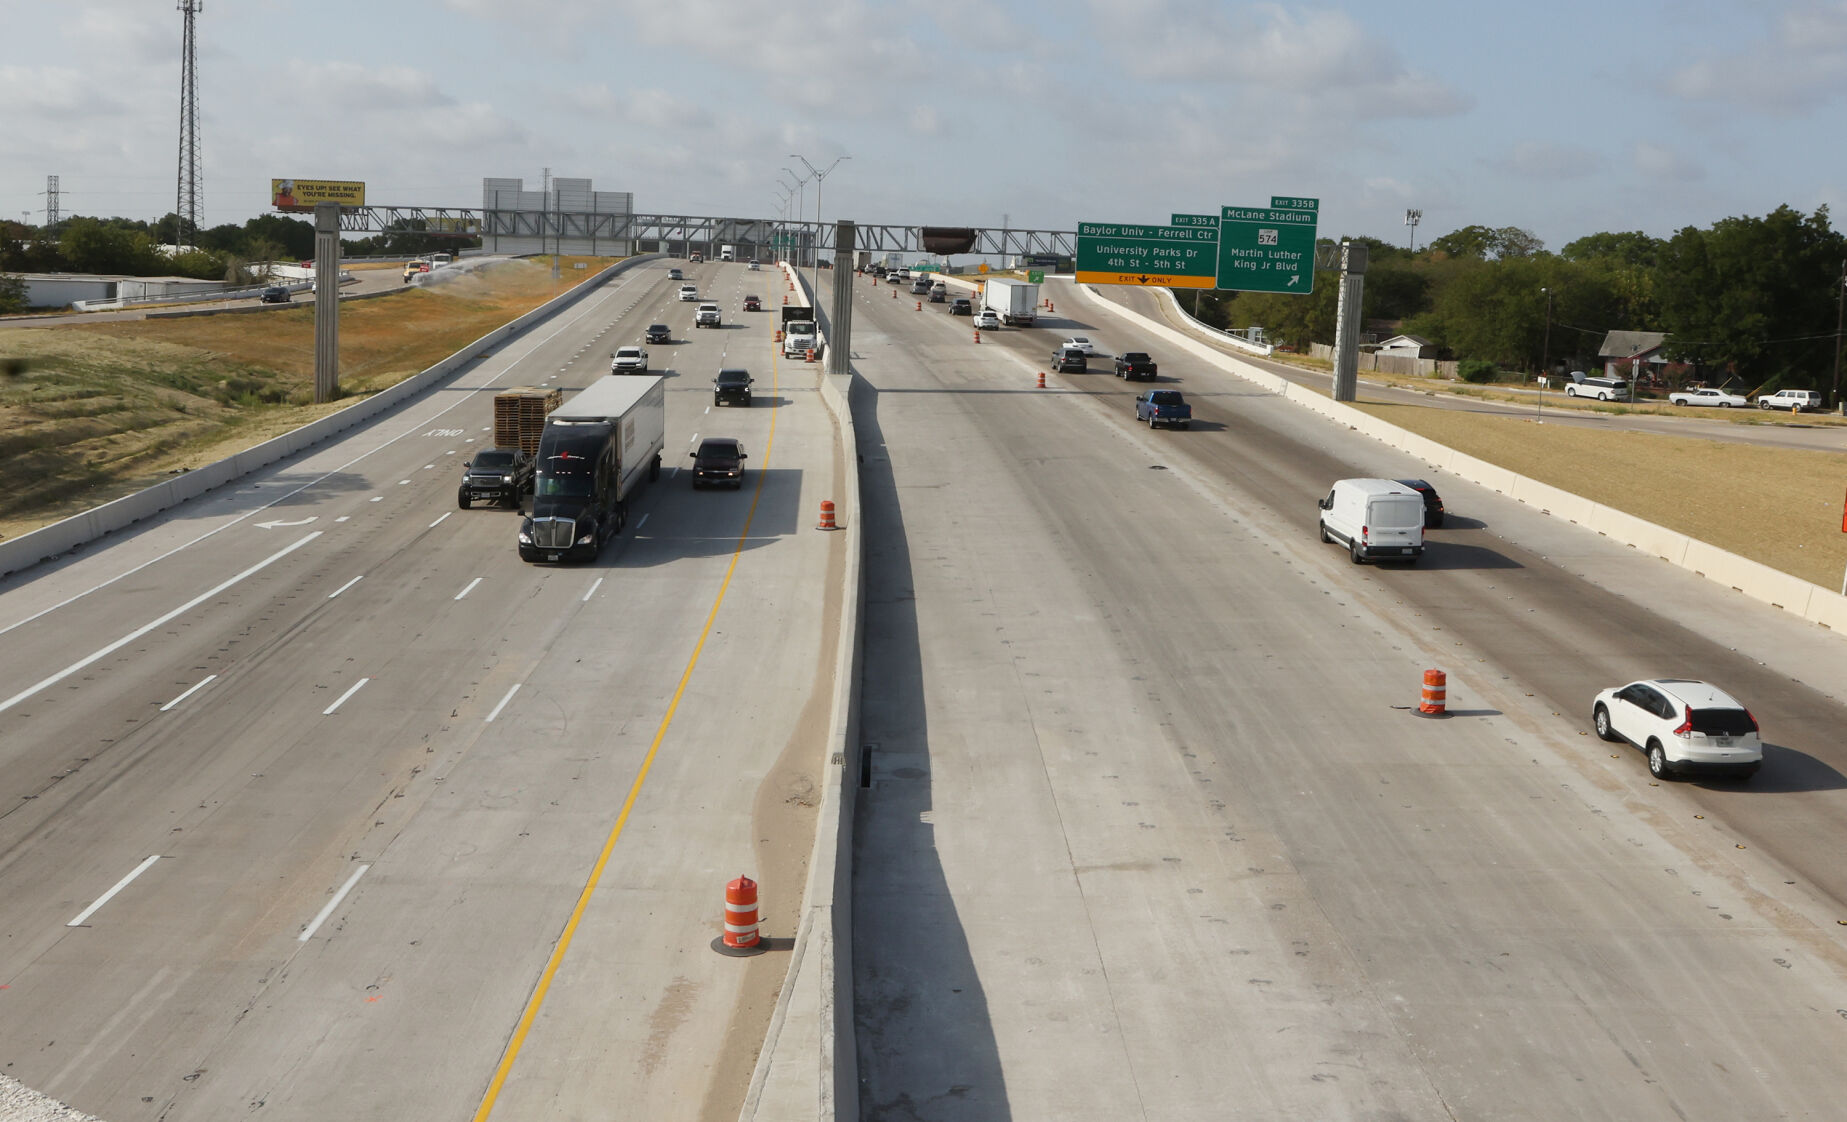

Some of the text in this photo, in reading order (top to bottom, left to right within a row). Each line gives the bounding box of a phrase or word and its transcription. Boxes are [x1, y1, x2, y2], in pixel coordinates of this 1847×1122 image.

[1291, 199, 1315, 208] 335B
[1192, 217, 1207, 225] 335
[1227, 210, 1311, 222] McLane Stadium
[1083, 225, 1117, 236] Baylor
[1121, 227, 1144, 236] Univ
[1158, 229, 1192, 239] Ferrell
[1197, 230, 1213, 239] Ctr
[1259, 234, 1277, 243] 574
[1096, 245, 1198, 258] University Parks Dr
[1231, 248, 1302, 260] Martin Luther
[1108, 258, 1125, 267] 4th
[1130, 259, 1140, 268] St
[1154, 260, 1170, 269] 5th
[1175, 261, 1186, 270] St
[1234, 260, 1298, 271] King Jr Blvd
